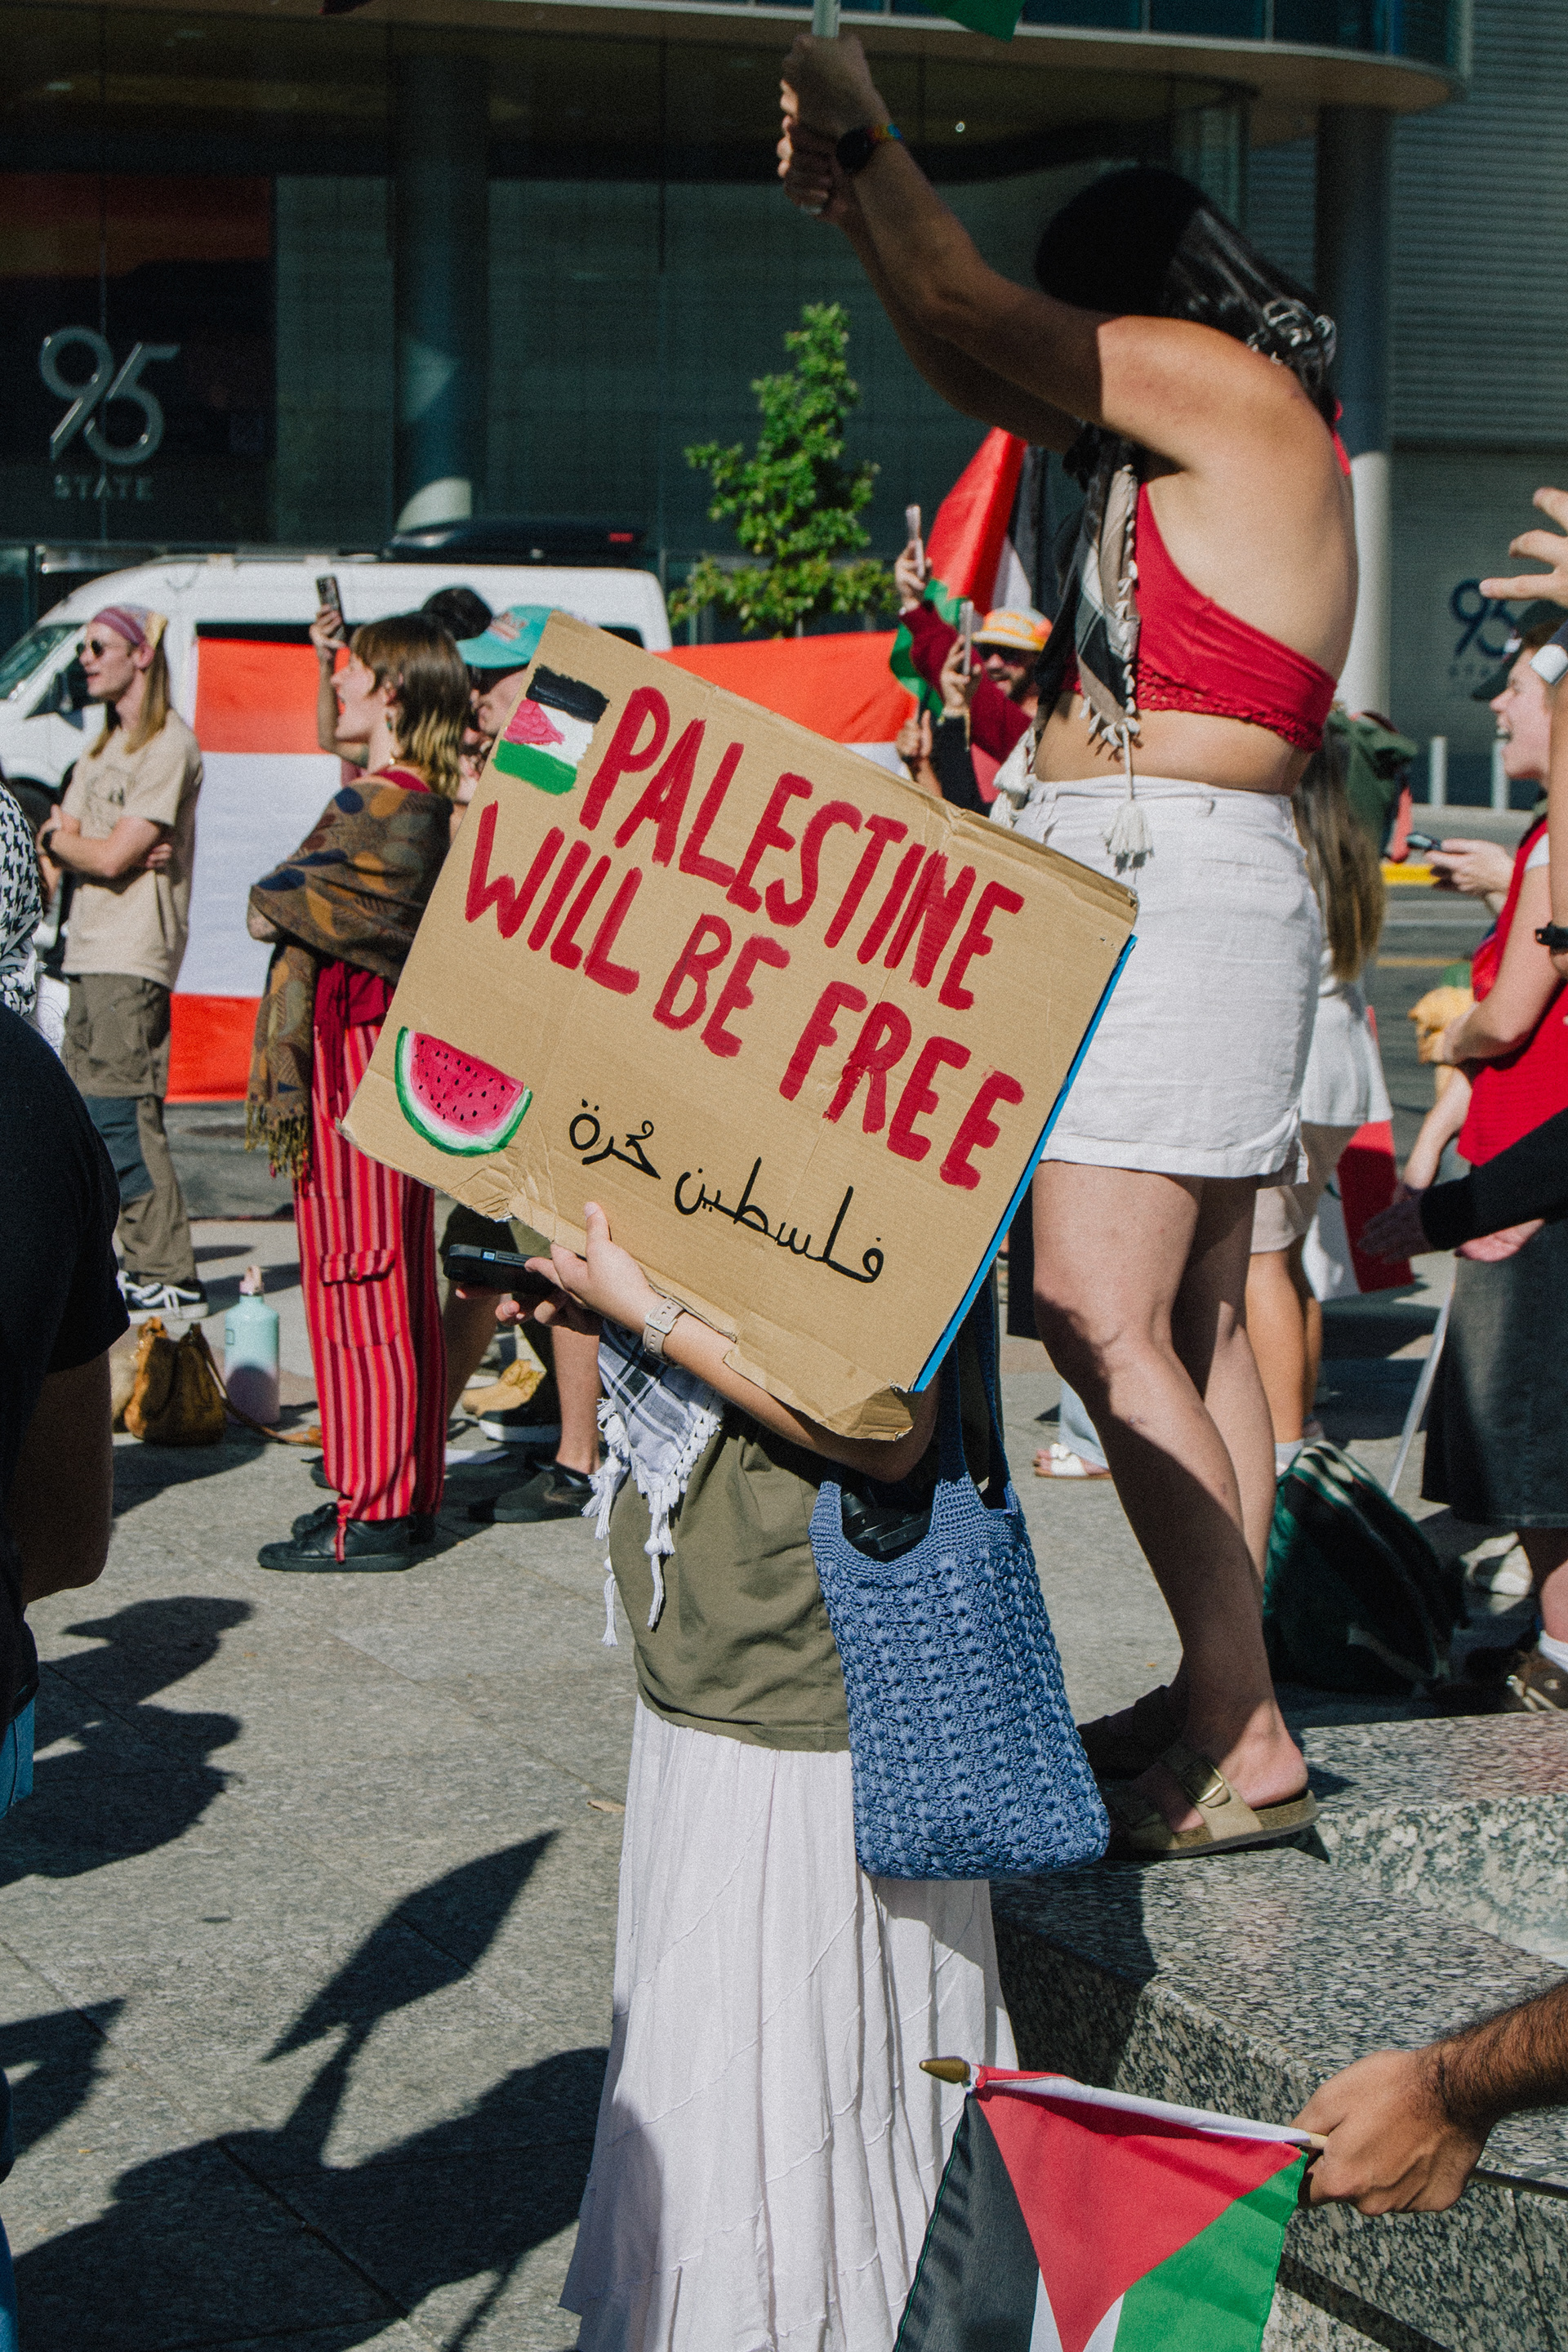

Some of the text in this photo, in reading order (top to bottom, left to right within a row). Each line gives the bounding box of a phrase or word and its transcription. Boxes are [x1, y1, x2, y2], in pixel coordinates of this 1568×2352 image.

[39, 326, 180, 465] 95
[54, 474, 154, 501] STATE
[578, 685, 1027, 1011] PALESTINE
[464, 800, 1027, 1192] WILL BE FREE
[674, 1156, 884, 1284] فلسطين
